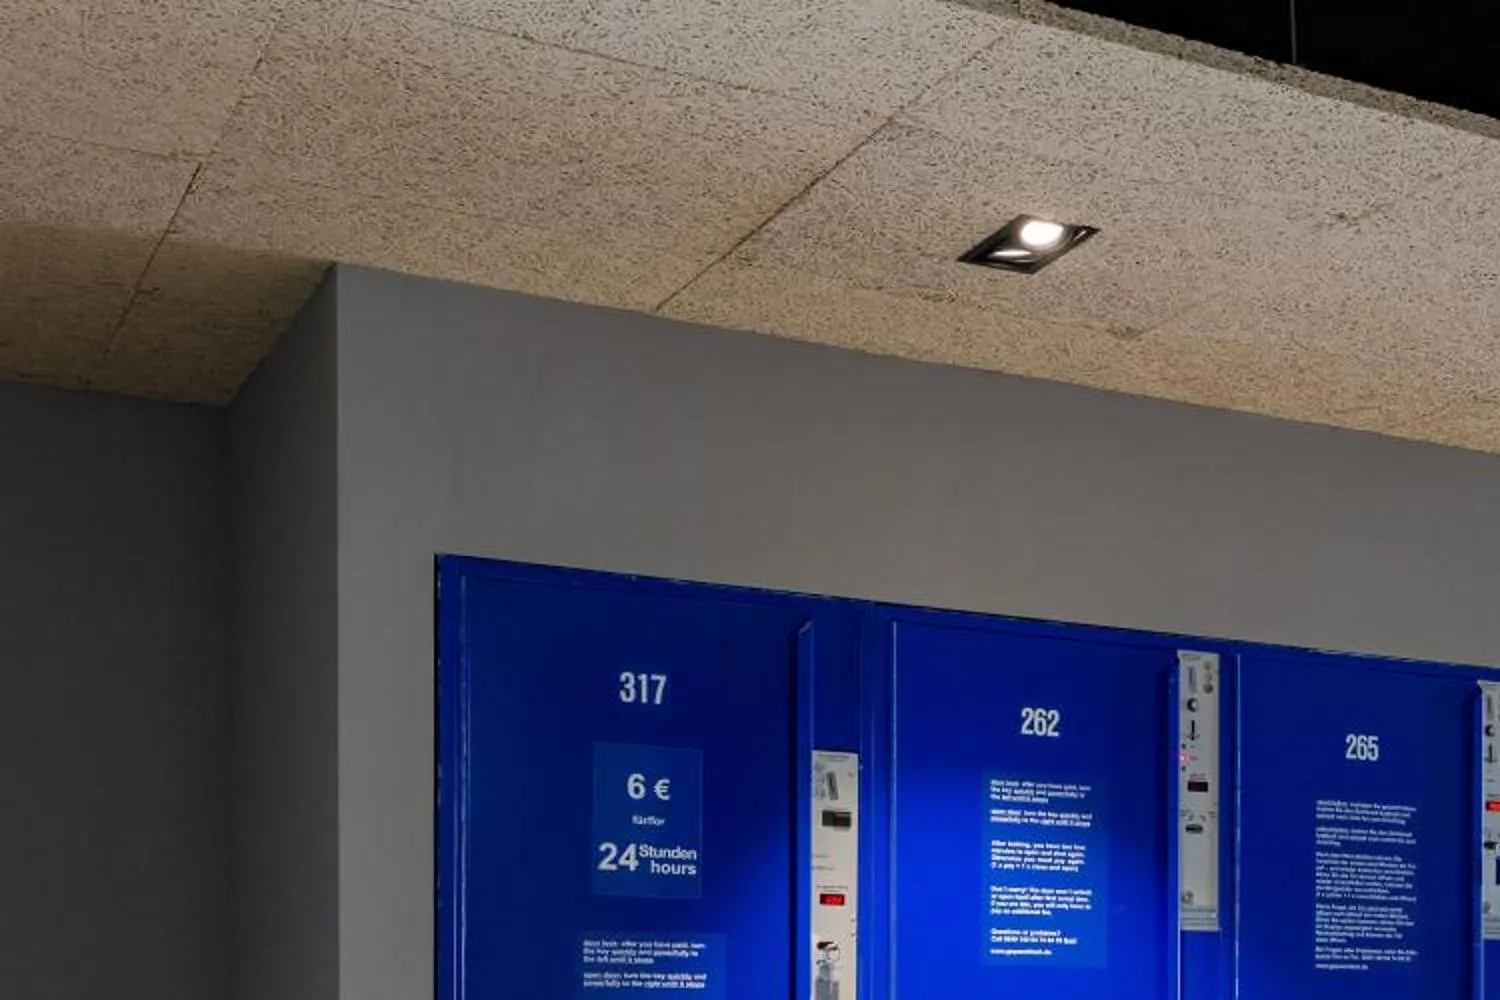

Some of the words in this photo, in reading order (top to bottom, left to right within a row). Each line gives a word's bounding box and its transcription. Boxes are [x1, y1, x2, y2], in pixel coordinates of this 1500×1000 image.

[620, 672, 666, 704] 317
[1021, 708, 1059, 736] 262
[1346, 734, 1378, 760] 265
[628, 774, 645, 799] 6
[654, 779, 670, 800] €
[598, 842, 638, 871] 24
[640, 845, 696, 860] Stunden
[650, 860, 696, 875] hours
